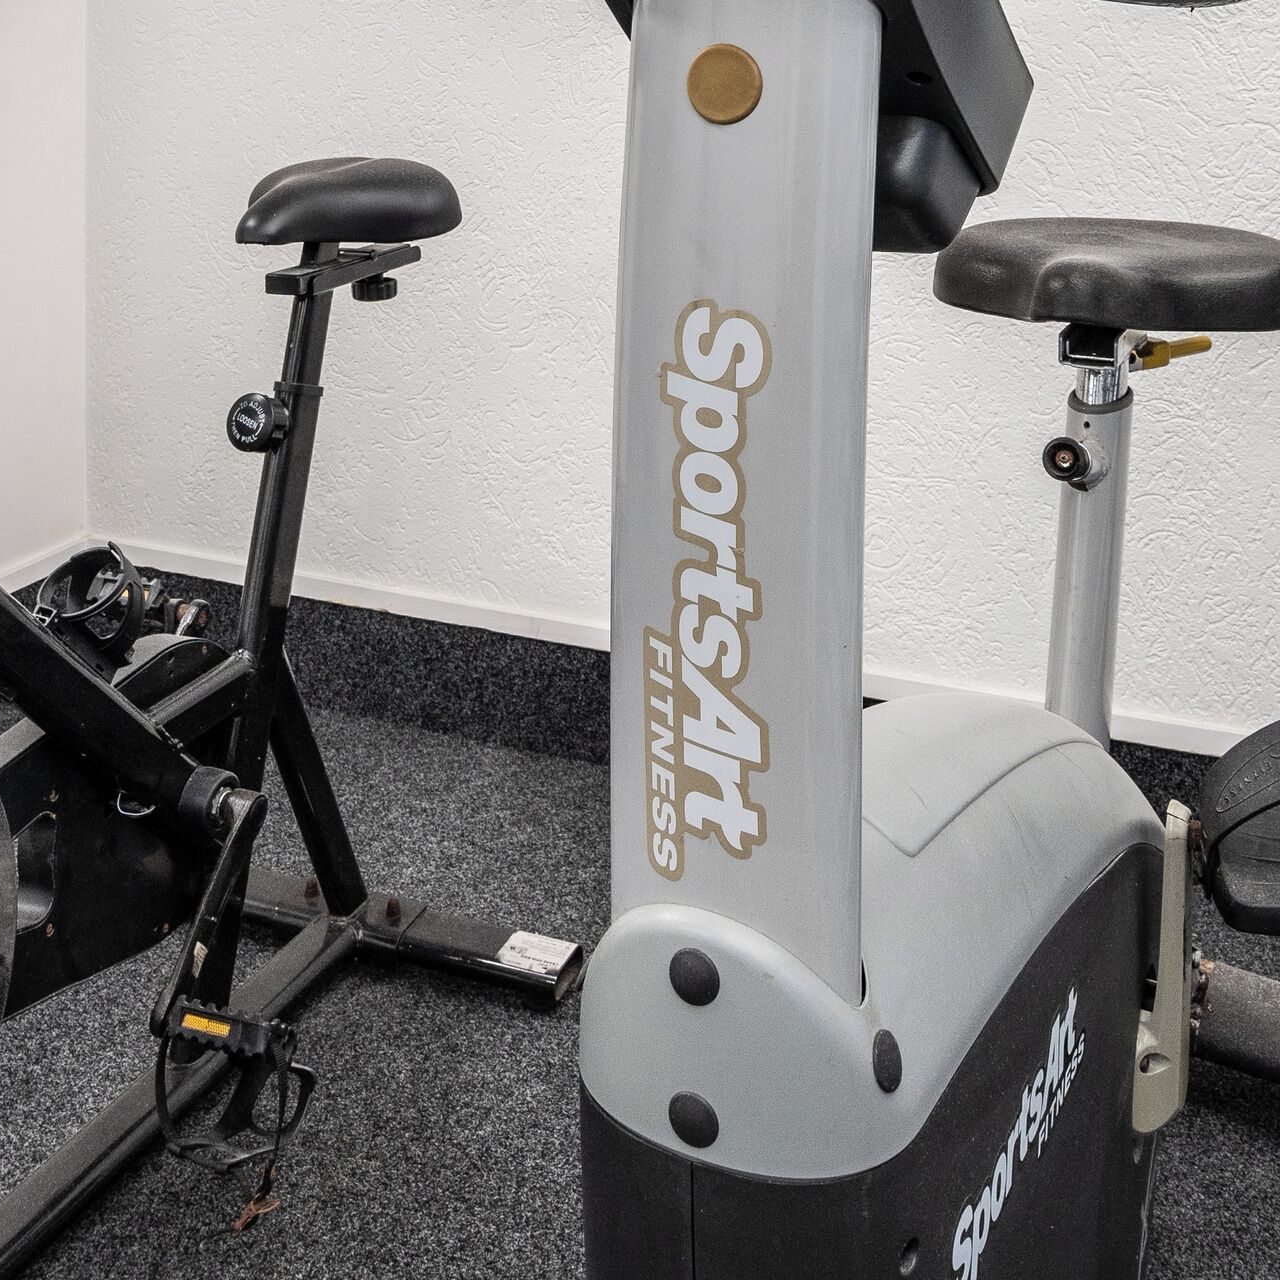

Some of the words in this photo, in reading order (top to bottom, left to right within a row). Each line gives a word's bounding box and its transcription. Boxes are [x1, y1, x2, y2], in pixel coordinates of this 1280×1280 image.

[231, 421, 240, 440] THEN
[241, 434, 258, 444] PULL
[237, 413, 259, 430] LOOSEN
[240, 401, 248, 409] TO
[249, 400, 266, 423] ADJUST
[666, 307, 765, 853] SportsArt
[648, 635, 678, 870] FITNESS
[952, 986, 1078, 1280] SportsArt
[1037, 1032, 1085, 1158] FITNESS
